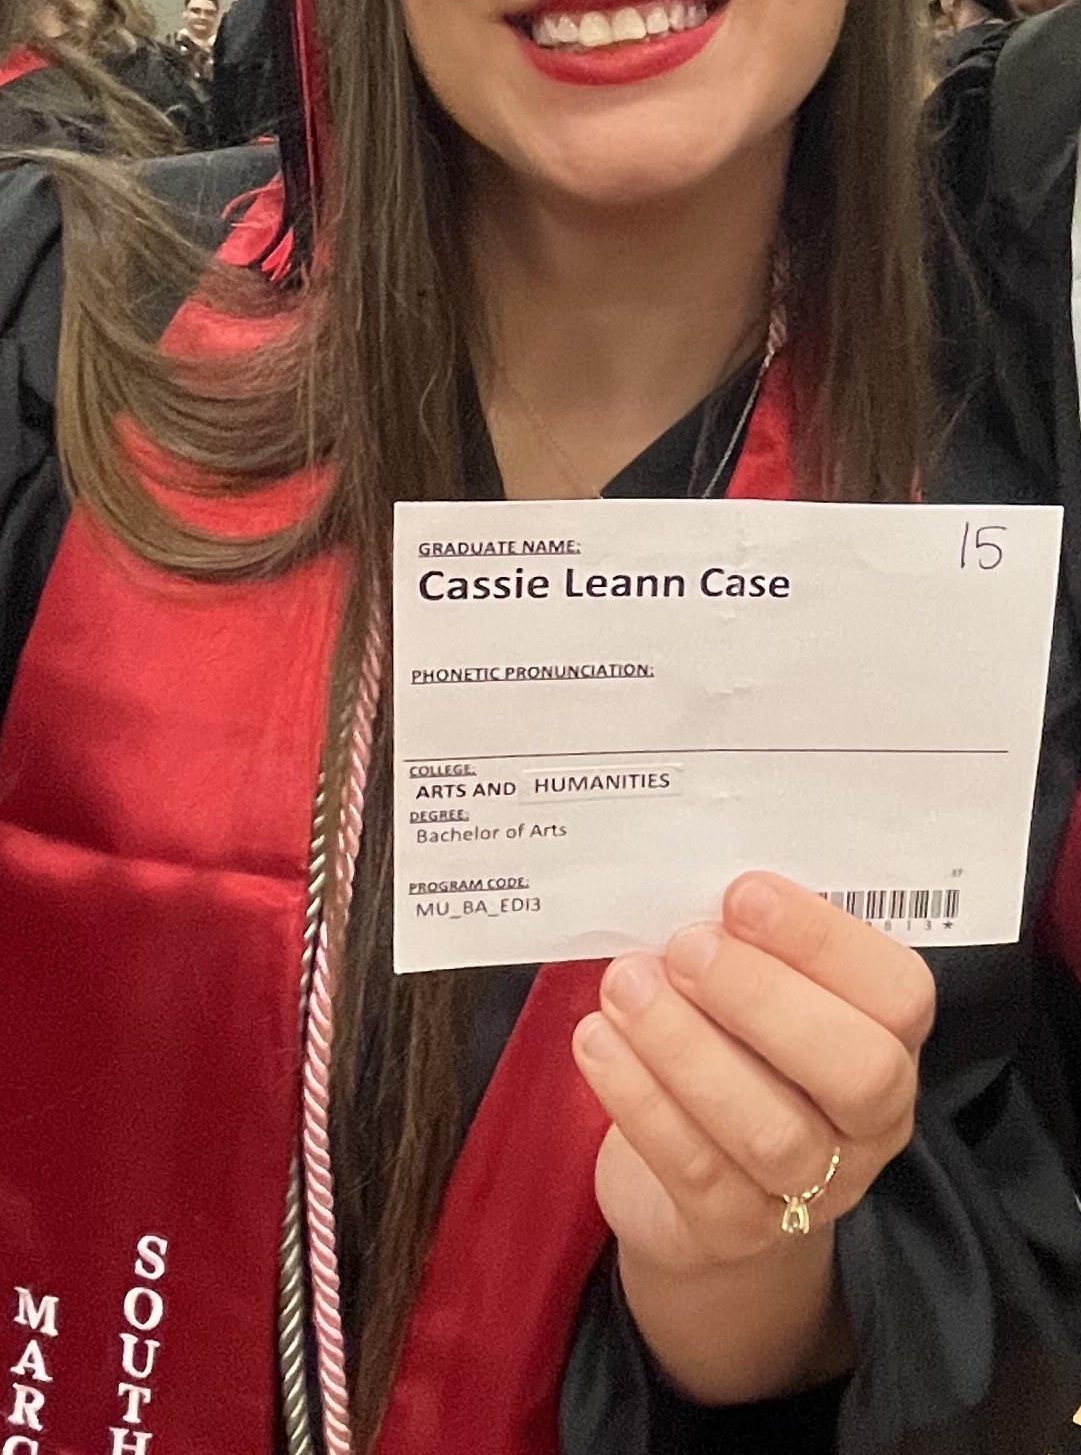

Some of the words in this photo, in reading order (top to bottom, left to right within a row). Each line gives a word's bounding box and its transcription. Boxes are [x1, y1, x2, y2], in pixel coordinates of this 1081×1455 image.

[418, 541, 516, 558] GRADUATE
[522, 539, 582, 555] NAME:
[961, 521, 1008, 570] 15
[418, 567, 550, 601] Cassie
[565, 567, 686, 598] Leann
[699, 567, 791, 599] Case
[411, 667, 501, 685] PHONETIC
[504, 664, 655, 681] PRONUNCIATION:
[409, 764, 477, 780] COLLEGE:
[416, 783, 467, 800] ARTS
[472, 782, 517, 797] AND
[535, 773, 671, 794] HUMANITIES
[409, 809, 469, 825] DEGREE:
[417, 826, 500, 844] Bachelor
[506, 823, 525, 840] of
[530, 824, 568, 839] Arts
[409, 881, 483, 896] PROGRAM
[487, 877, 530, 891] CODE:
[109, 1235, 168, 1455] SOUTH
